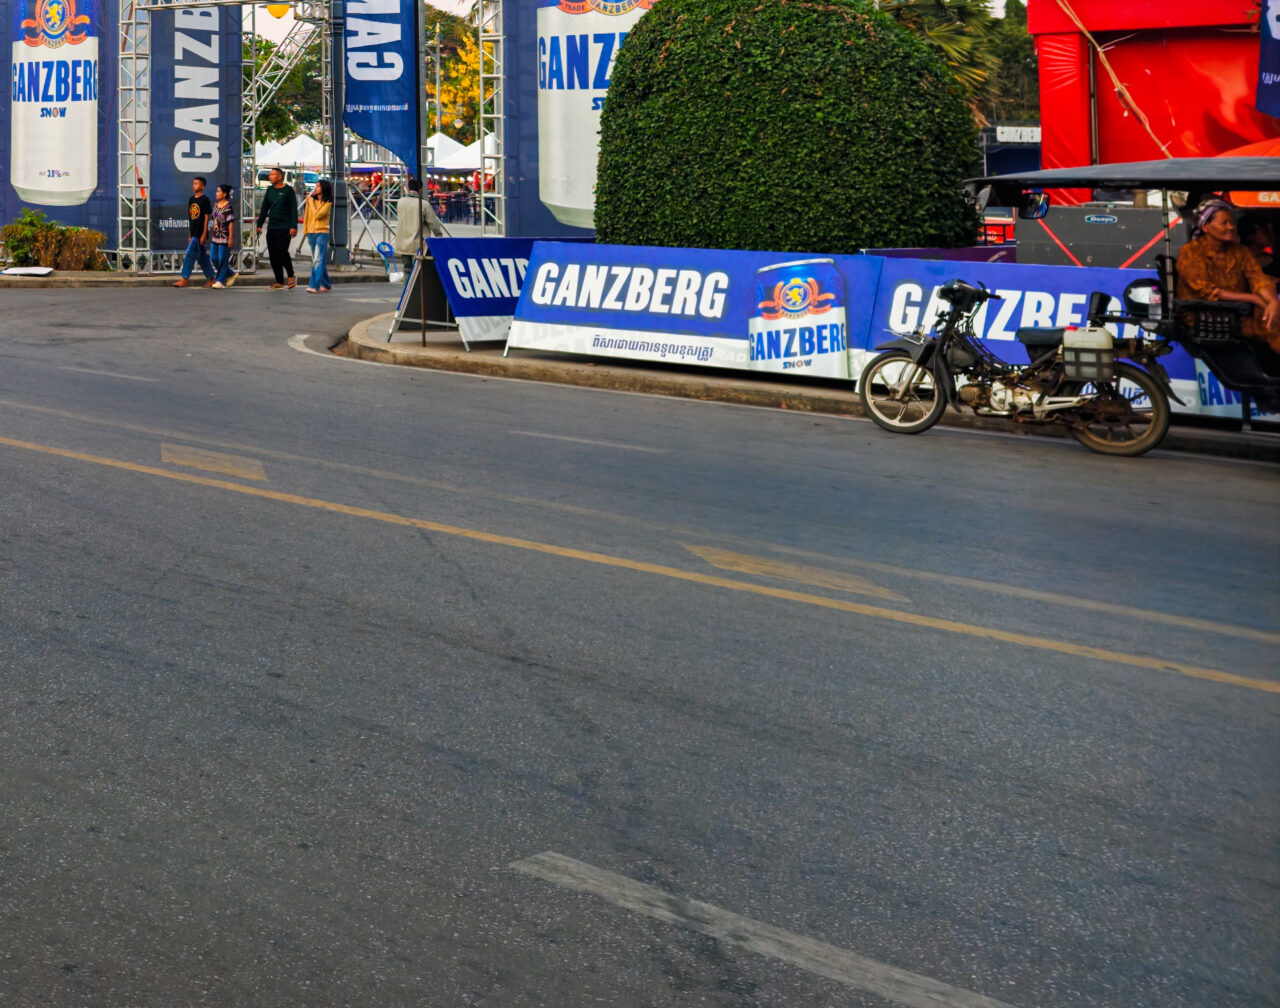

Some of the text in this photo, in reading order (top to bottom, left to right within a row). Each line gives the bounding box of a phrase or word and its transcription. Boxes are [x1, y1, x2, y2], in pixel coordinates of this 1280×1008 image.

[12, 59, 98, 102] GANZBERG
[538, 32, 630, 90] GANZ
[447, 258, 529, 299] GANZ
[531, 262, 729, 319] GANZBERG
[749, 322, 847, 361] GANZBERG
